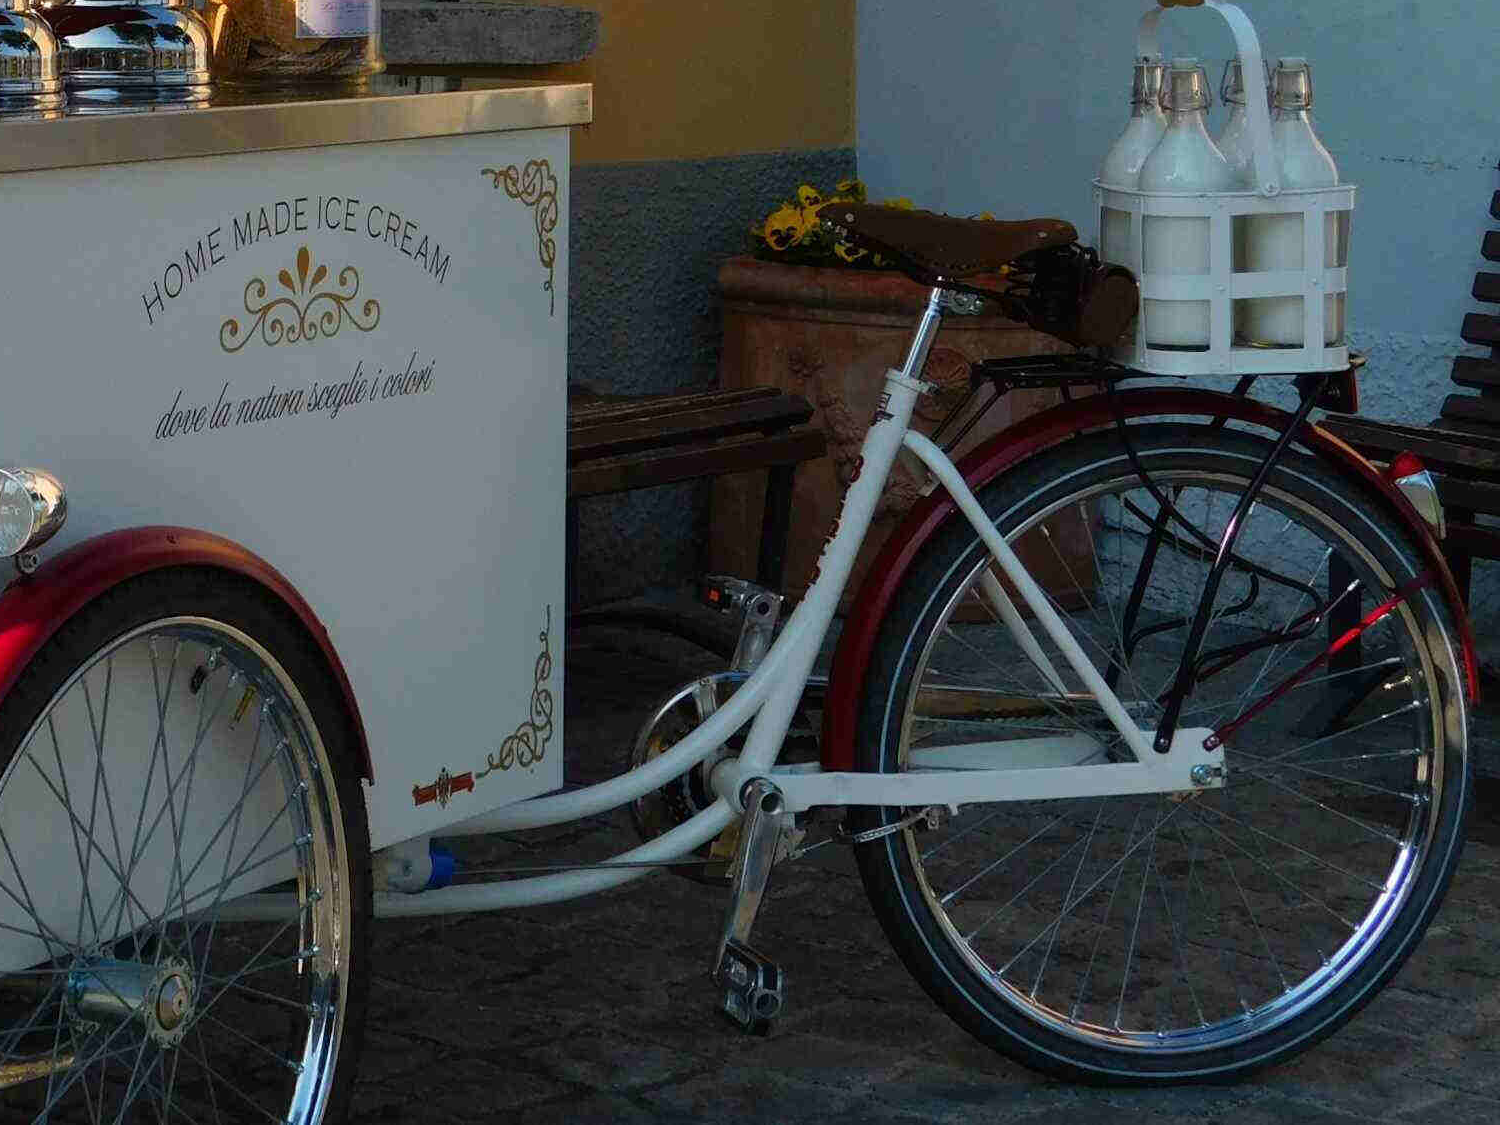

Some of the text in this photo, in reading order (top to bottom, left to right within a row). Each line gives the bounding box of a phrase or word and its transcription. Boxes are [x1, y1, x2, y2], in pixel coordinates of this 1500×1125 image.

[140, 195, 452, 325] HOME MADE ICE CREAM
[155, 351, 436, 440] dove la natura sceglie i colori
